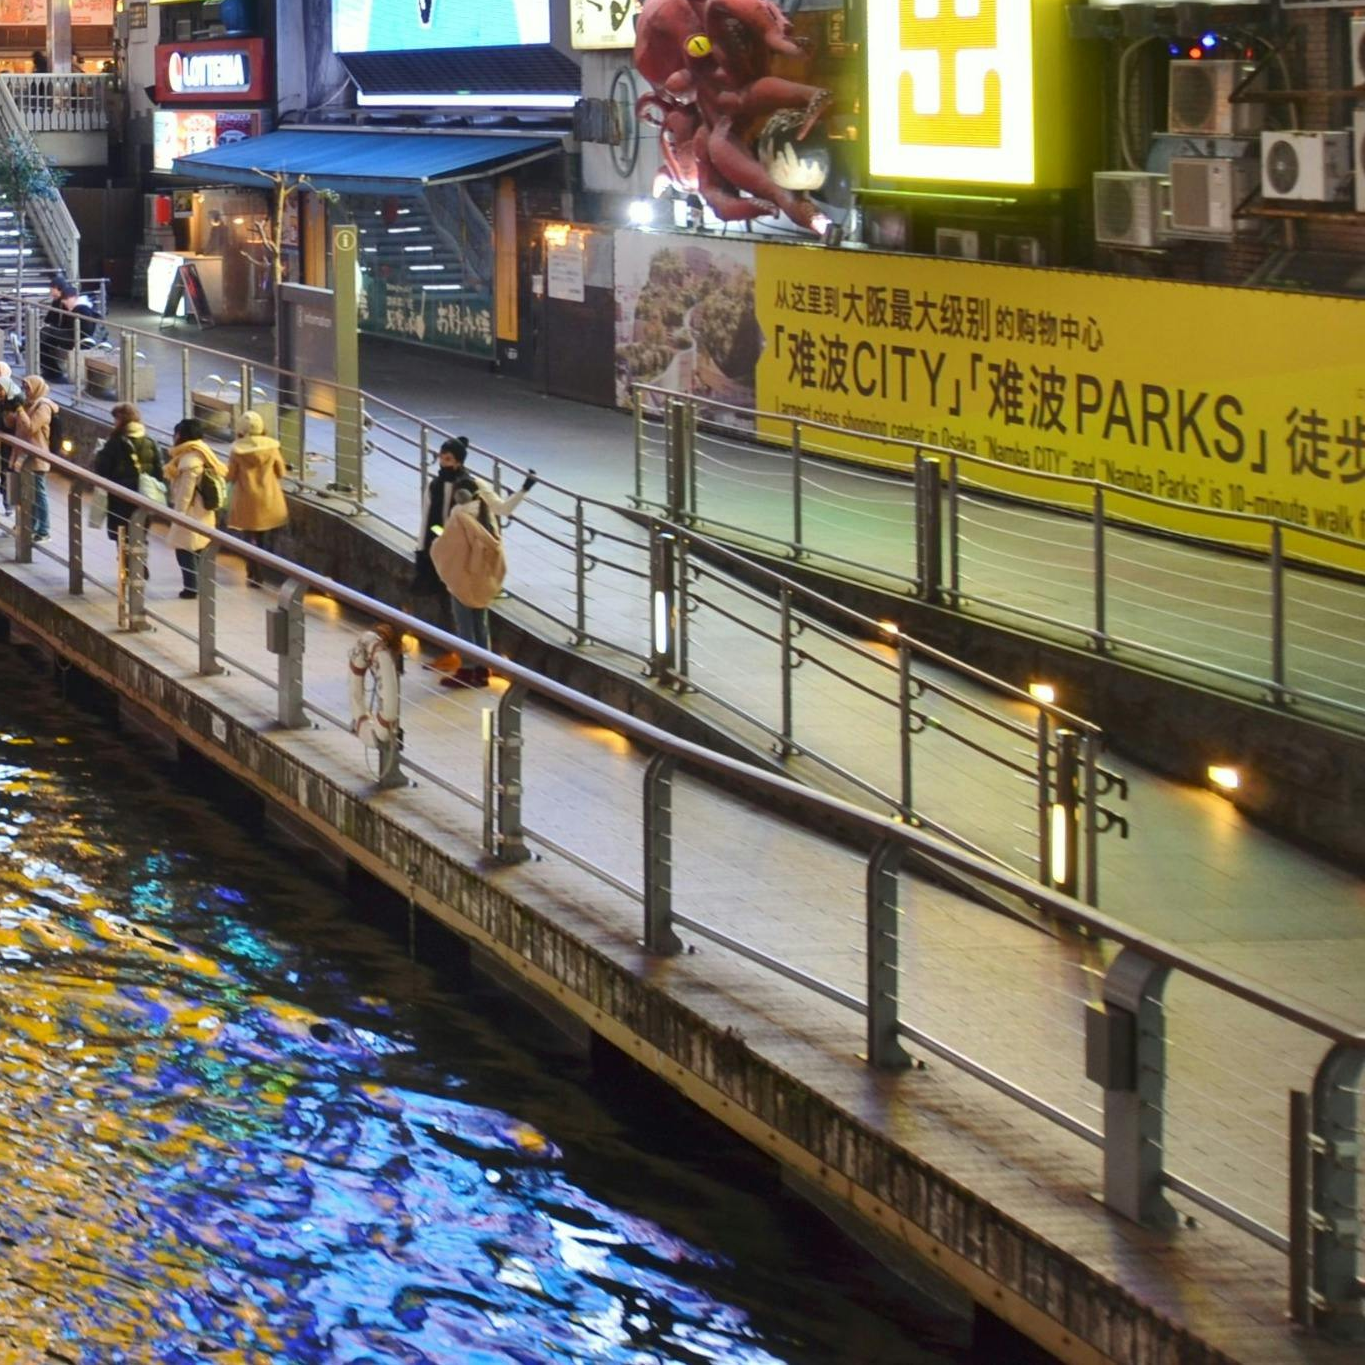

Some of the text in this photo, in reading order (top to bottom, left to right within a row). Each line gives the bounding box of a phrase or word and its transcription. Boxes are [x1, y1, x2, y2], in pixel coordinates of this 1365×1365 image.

[181, 53, 246, 88] LOTTERIA
[1072, 457, 1095, 479] and
[1210, 480, 1223, 508] is
[1313, 500, 1354, 536] walk
